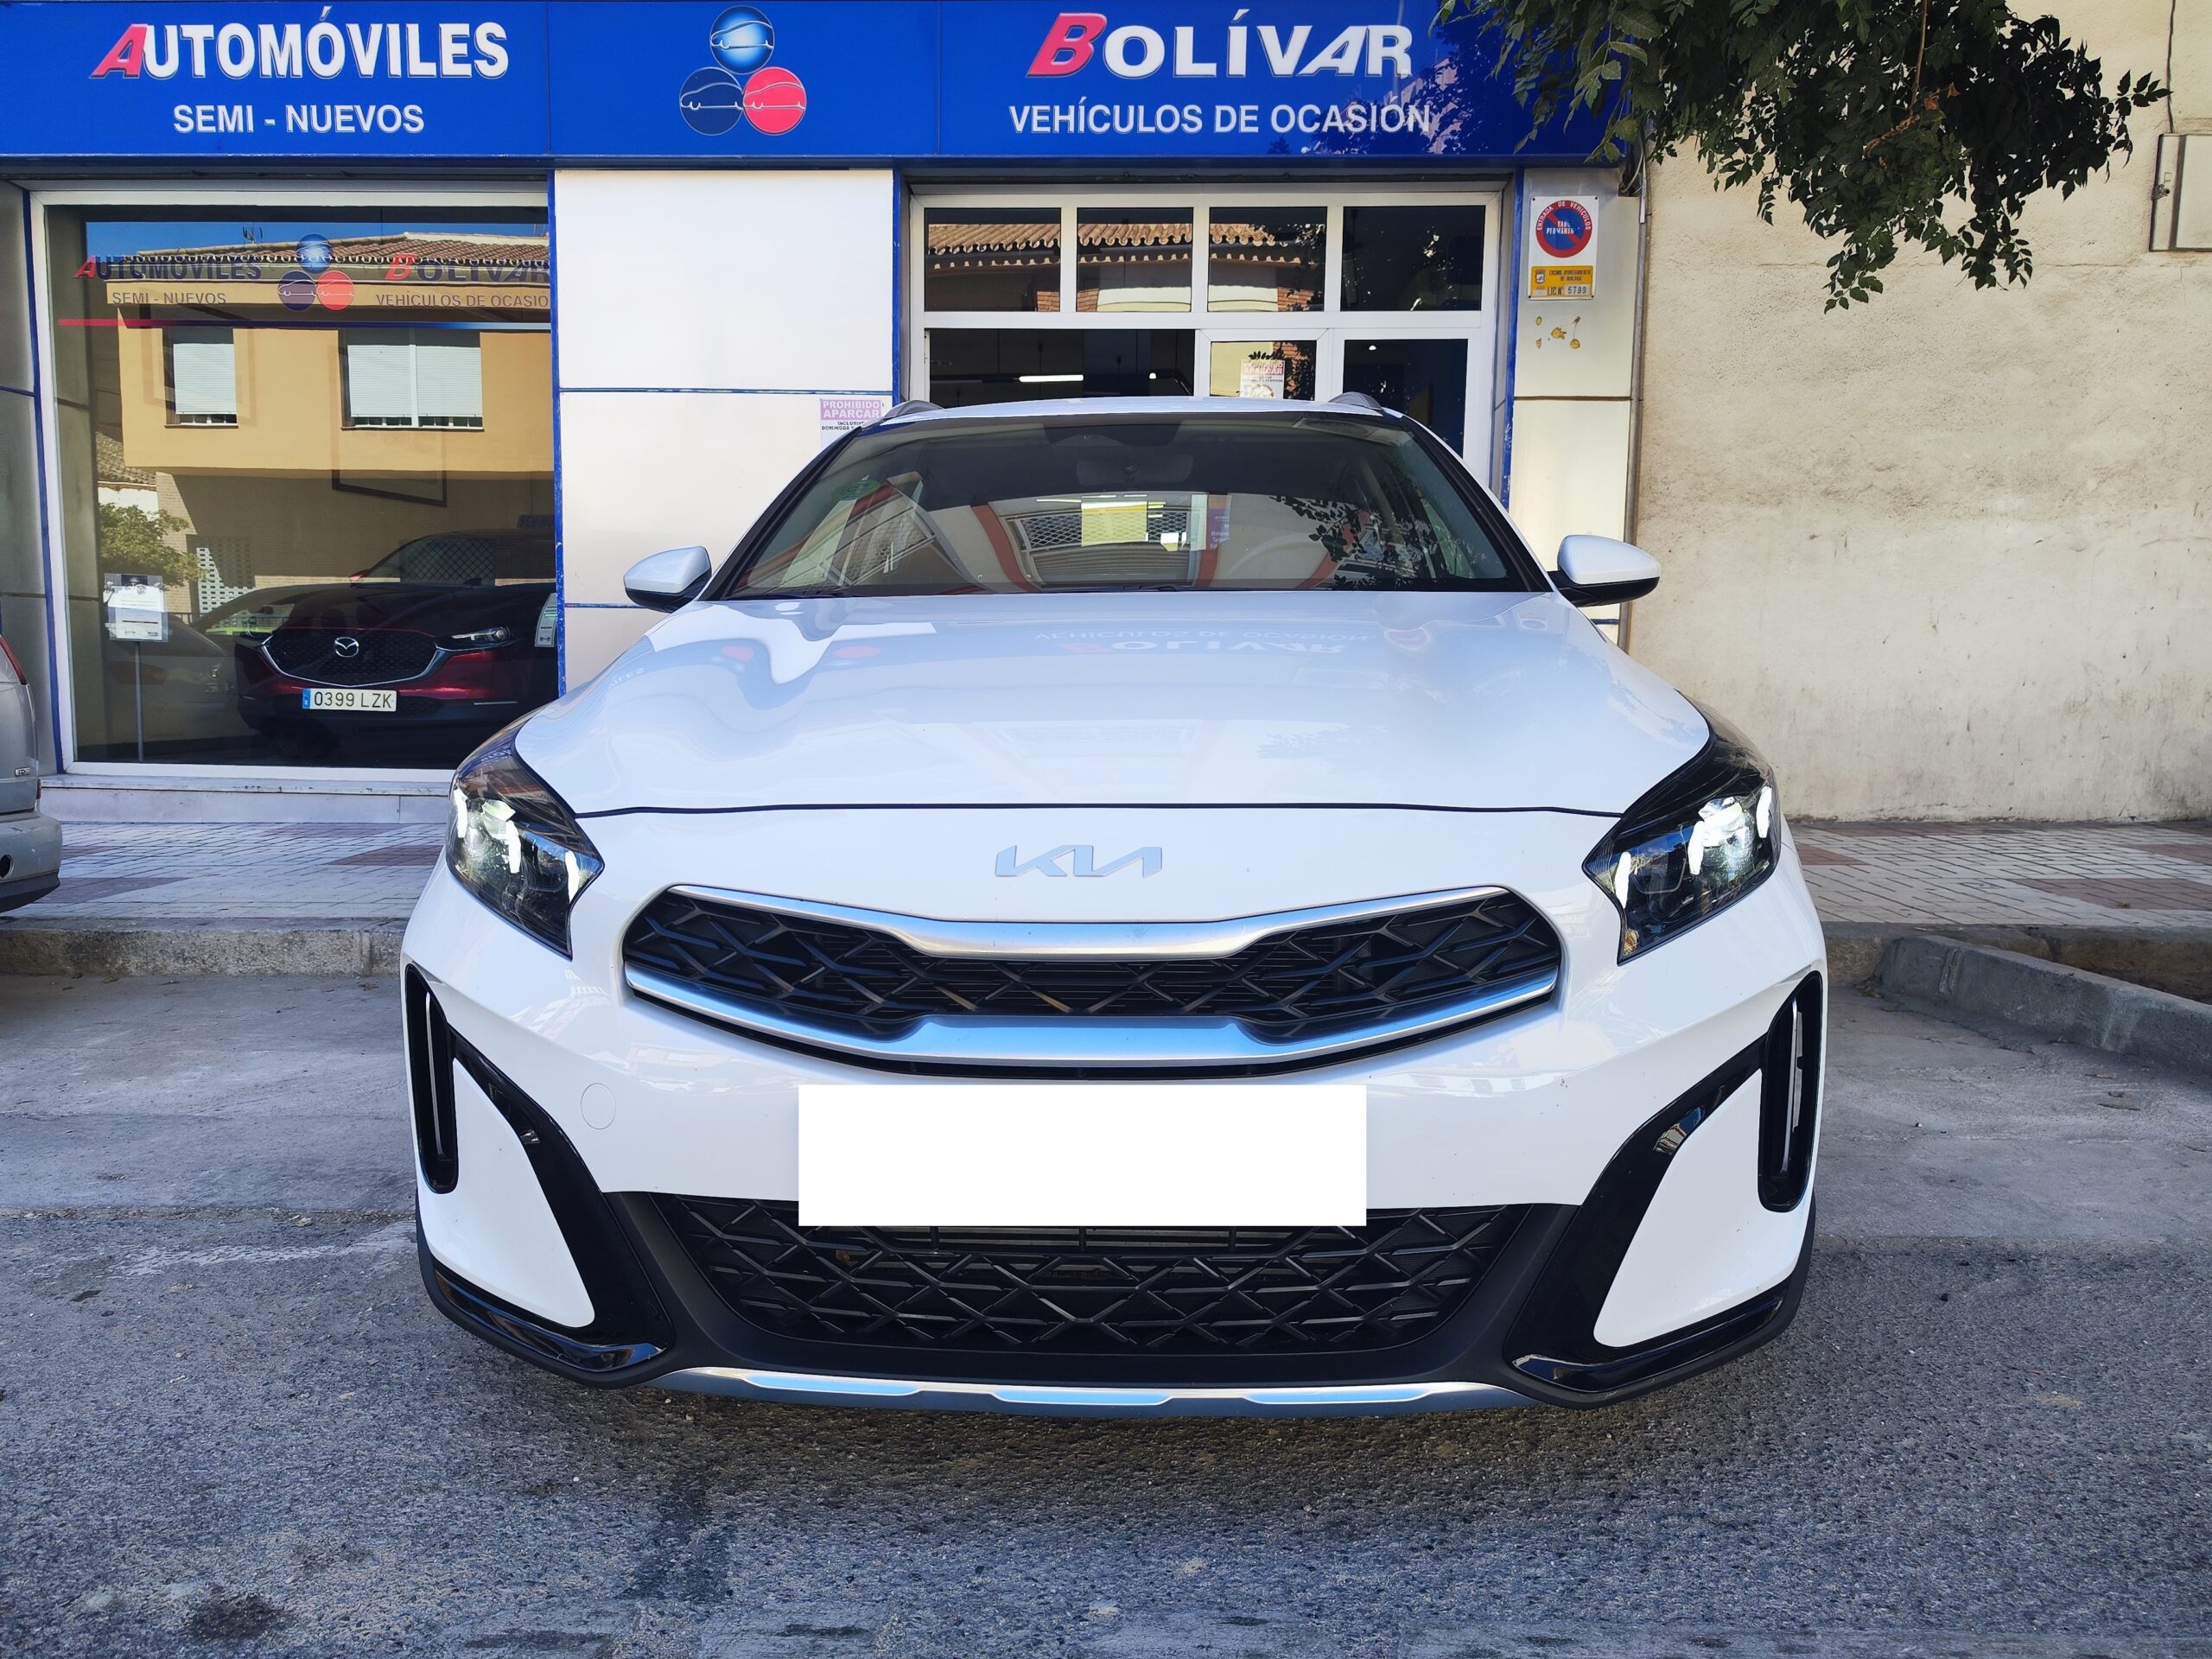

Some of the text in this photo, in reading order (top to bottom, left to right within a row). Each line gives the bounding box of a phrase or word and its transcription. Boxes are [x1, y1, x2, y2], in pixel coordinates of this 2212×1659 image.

[89, 5, 509, 80] AUTOMÓVILES
[1025, 9, 1413, 80] BOLÍVAR
[173, 104, 254, 134] SEMI
[286, 104, 425, 134] NUEVOS
[1008, 95, 1430, 135] VEHÍCULOS DE OCASIÓN
[1536, 206, 1554, 231] ENTRADA
[112, 292, 149, 304] SEMI
[164, 293, 226, 305] NUEVOS
[466, 296, 486, 308] DE
[823, 409, 880, 418] APARCAR
[314, 691, 392, 709] 0399 LZK
